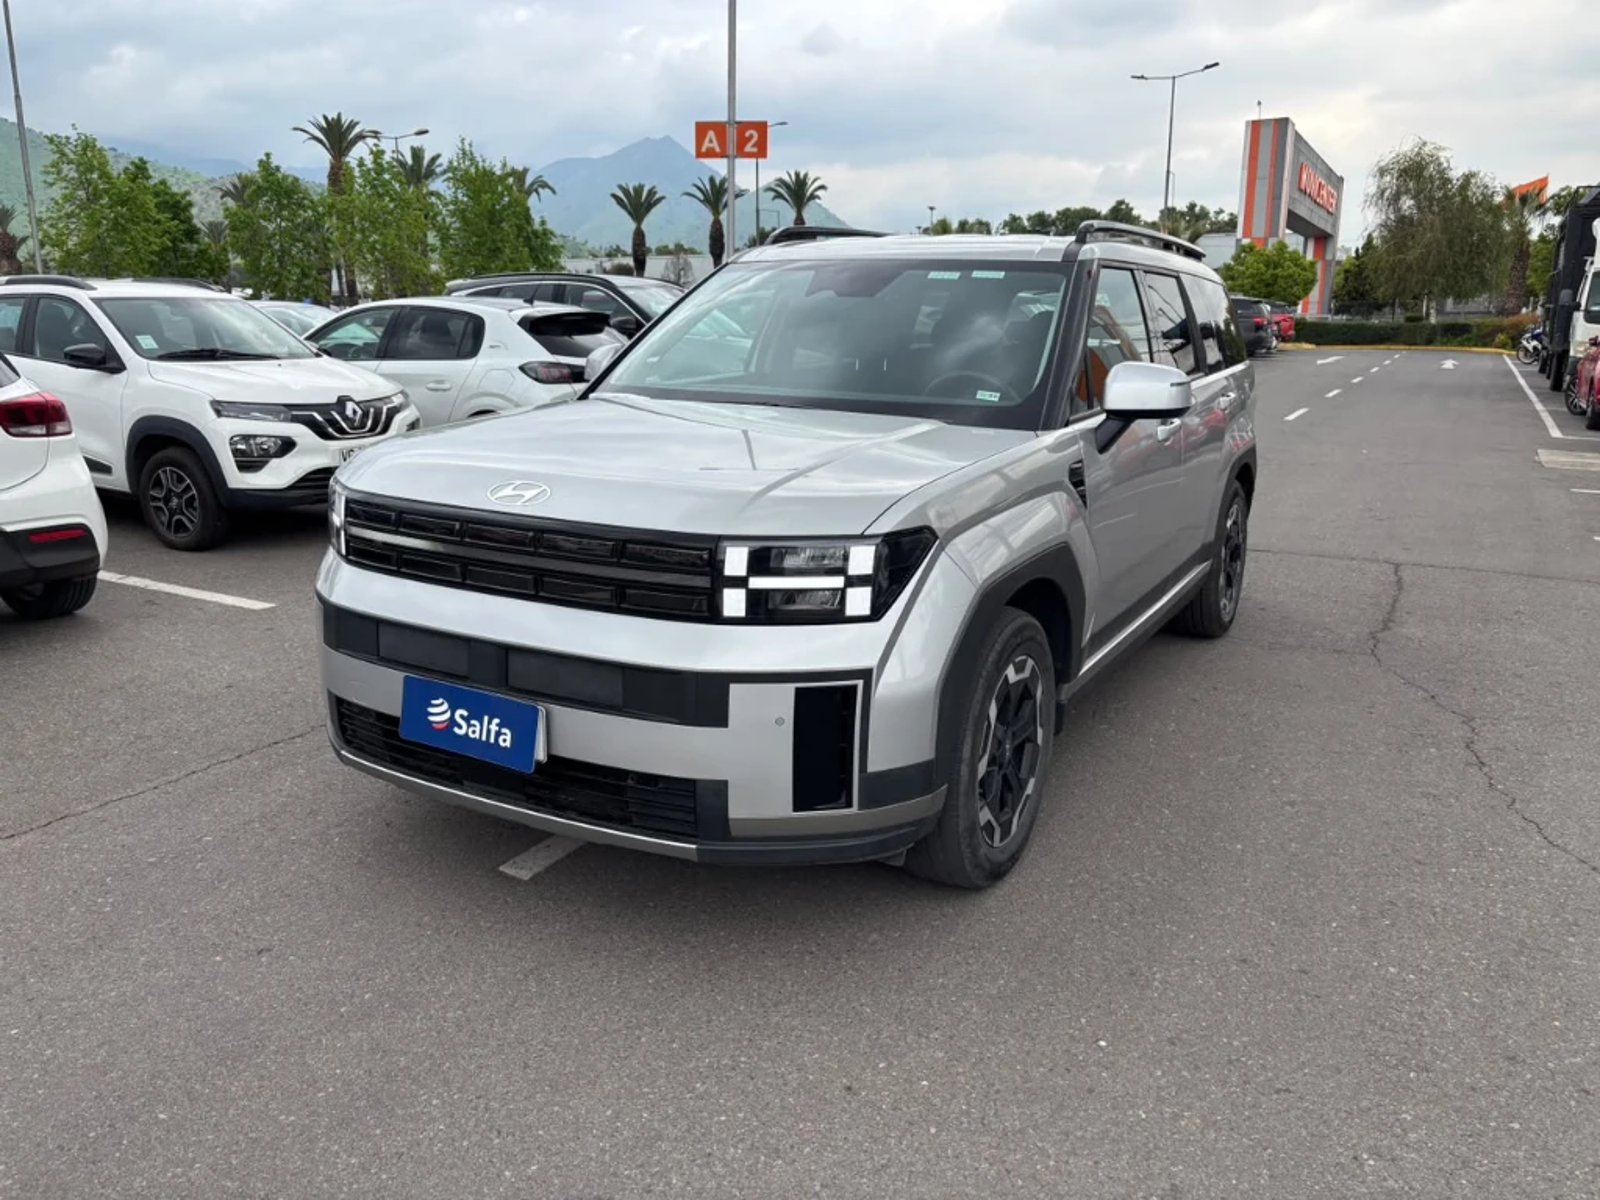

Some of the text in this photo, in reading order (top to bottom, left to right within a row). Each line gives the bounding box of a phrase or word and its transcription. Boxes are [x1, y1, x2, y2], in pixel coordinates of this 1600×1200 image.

[701, 129, 759, 153] A 2
[453, 708, 512, 748] Salfa
